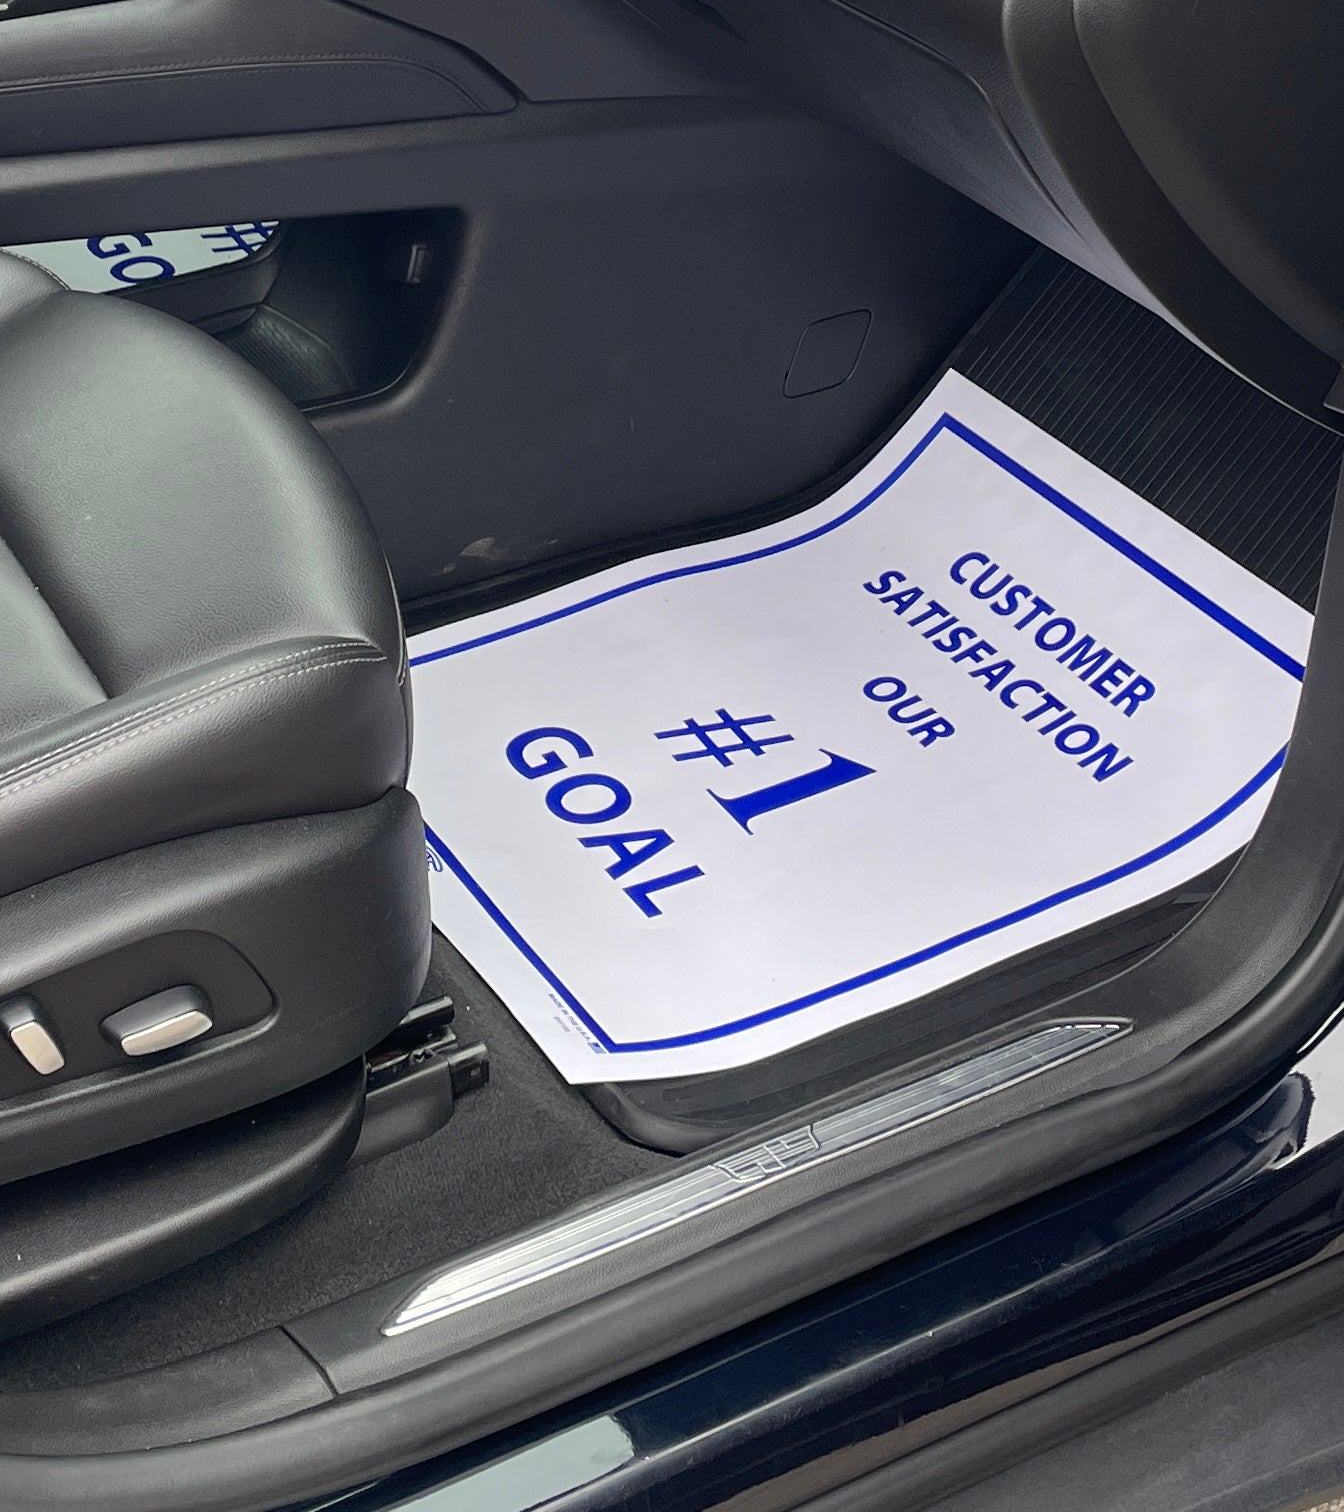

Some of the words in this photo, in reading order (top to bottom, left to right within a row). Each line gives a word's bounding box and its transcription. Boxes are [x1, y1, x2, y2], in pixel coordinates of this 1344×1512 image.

[863, 570, 1132, 782] SATISFACTION
[863, 676, 955, 747] OUR
[949, 551, 1156, 717] CUSTOMER
[505, 726, 704, 918] GOAL
[656, 708, 875, 834] #1
